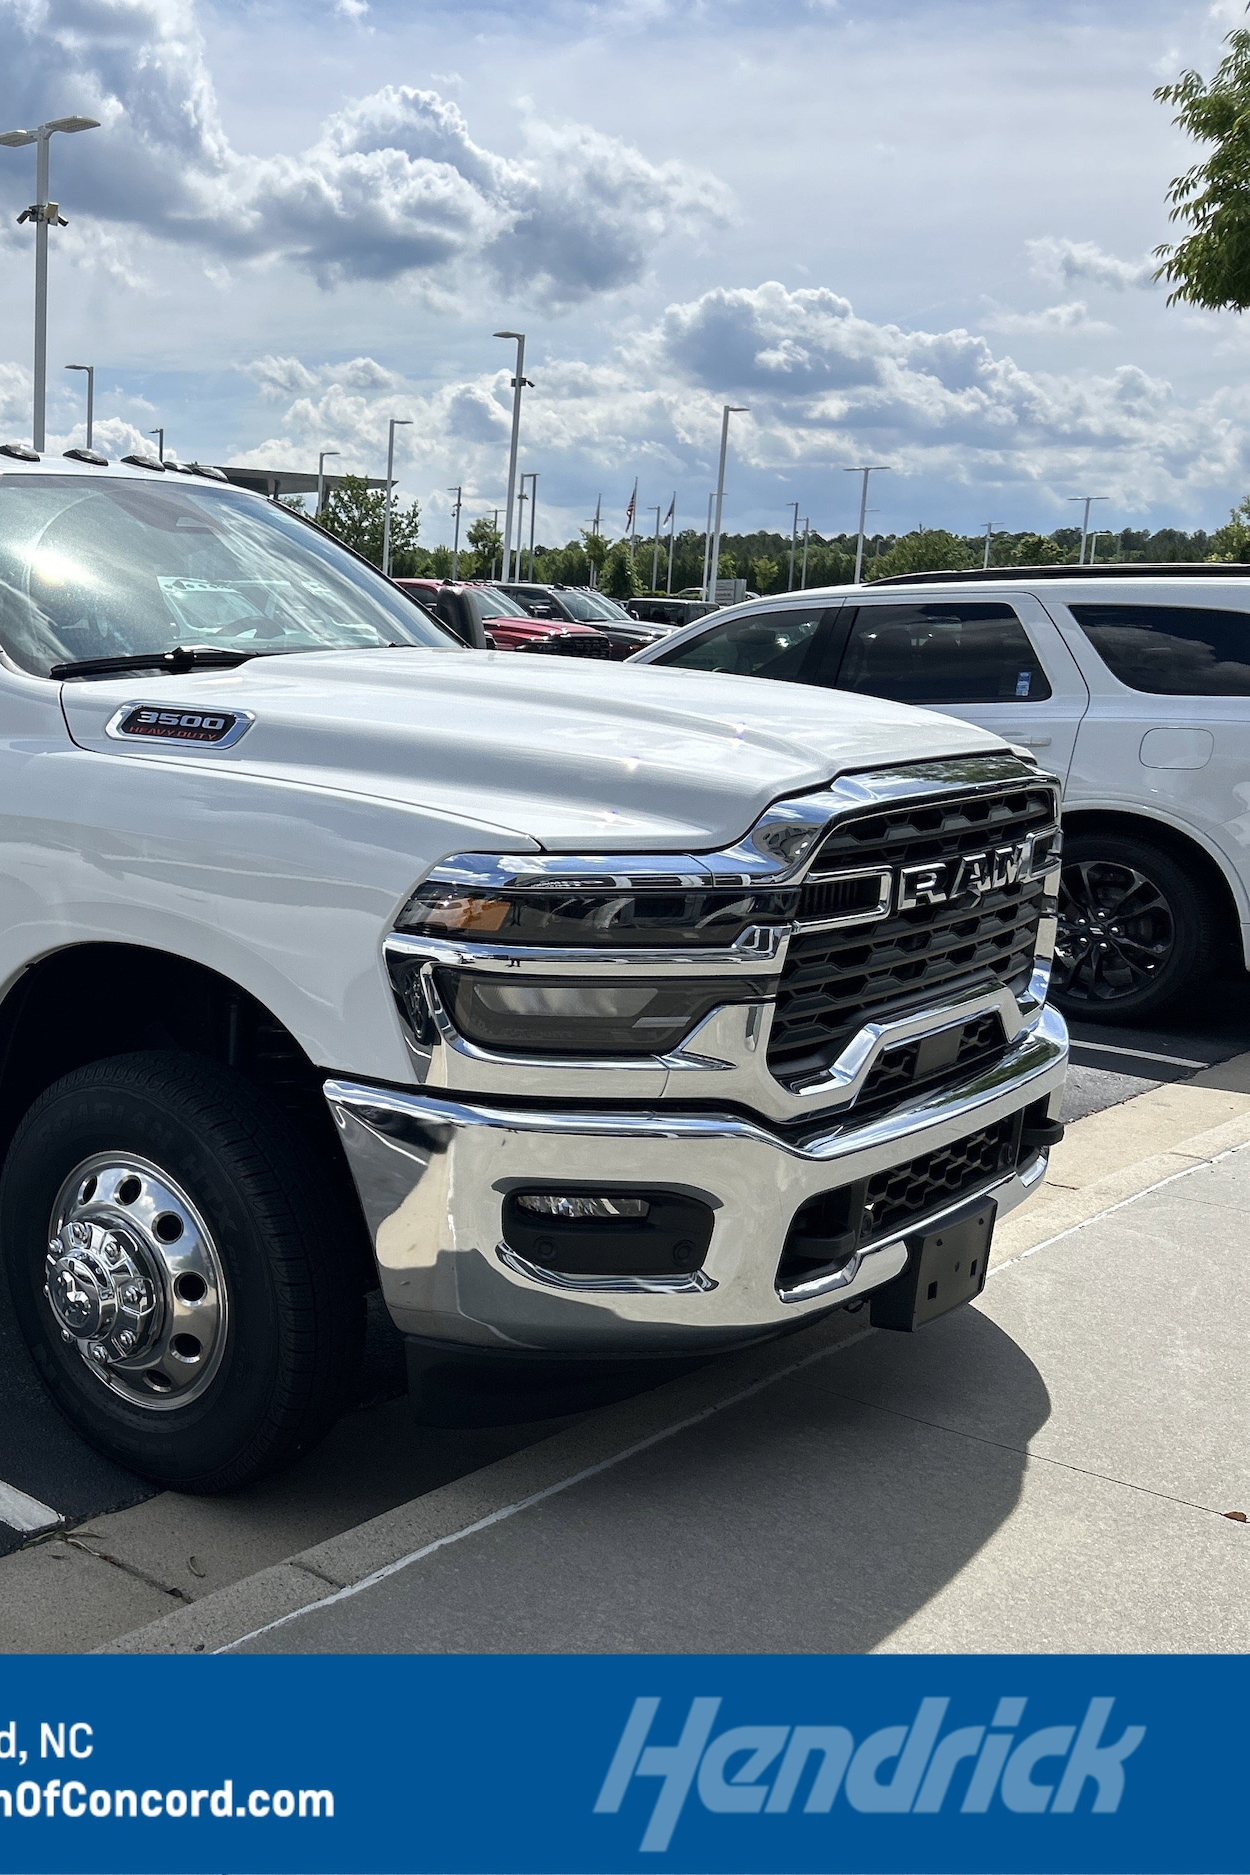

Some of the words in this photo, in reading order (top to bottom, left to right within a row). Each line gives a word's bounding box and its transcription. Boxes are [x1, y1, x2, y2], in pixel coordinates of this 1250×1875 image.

[137, 711, 225, 730] 3500
[129, 726, 176, 737] HEAVY
[176, 730, 217, 740] DUTY
[898, 842, 1032, 910] RAM
